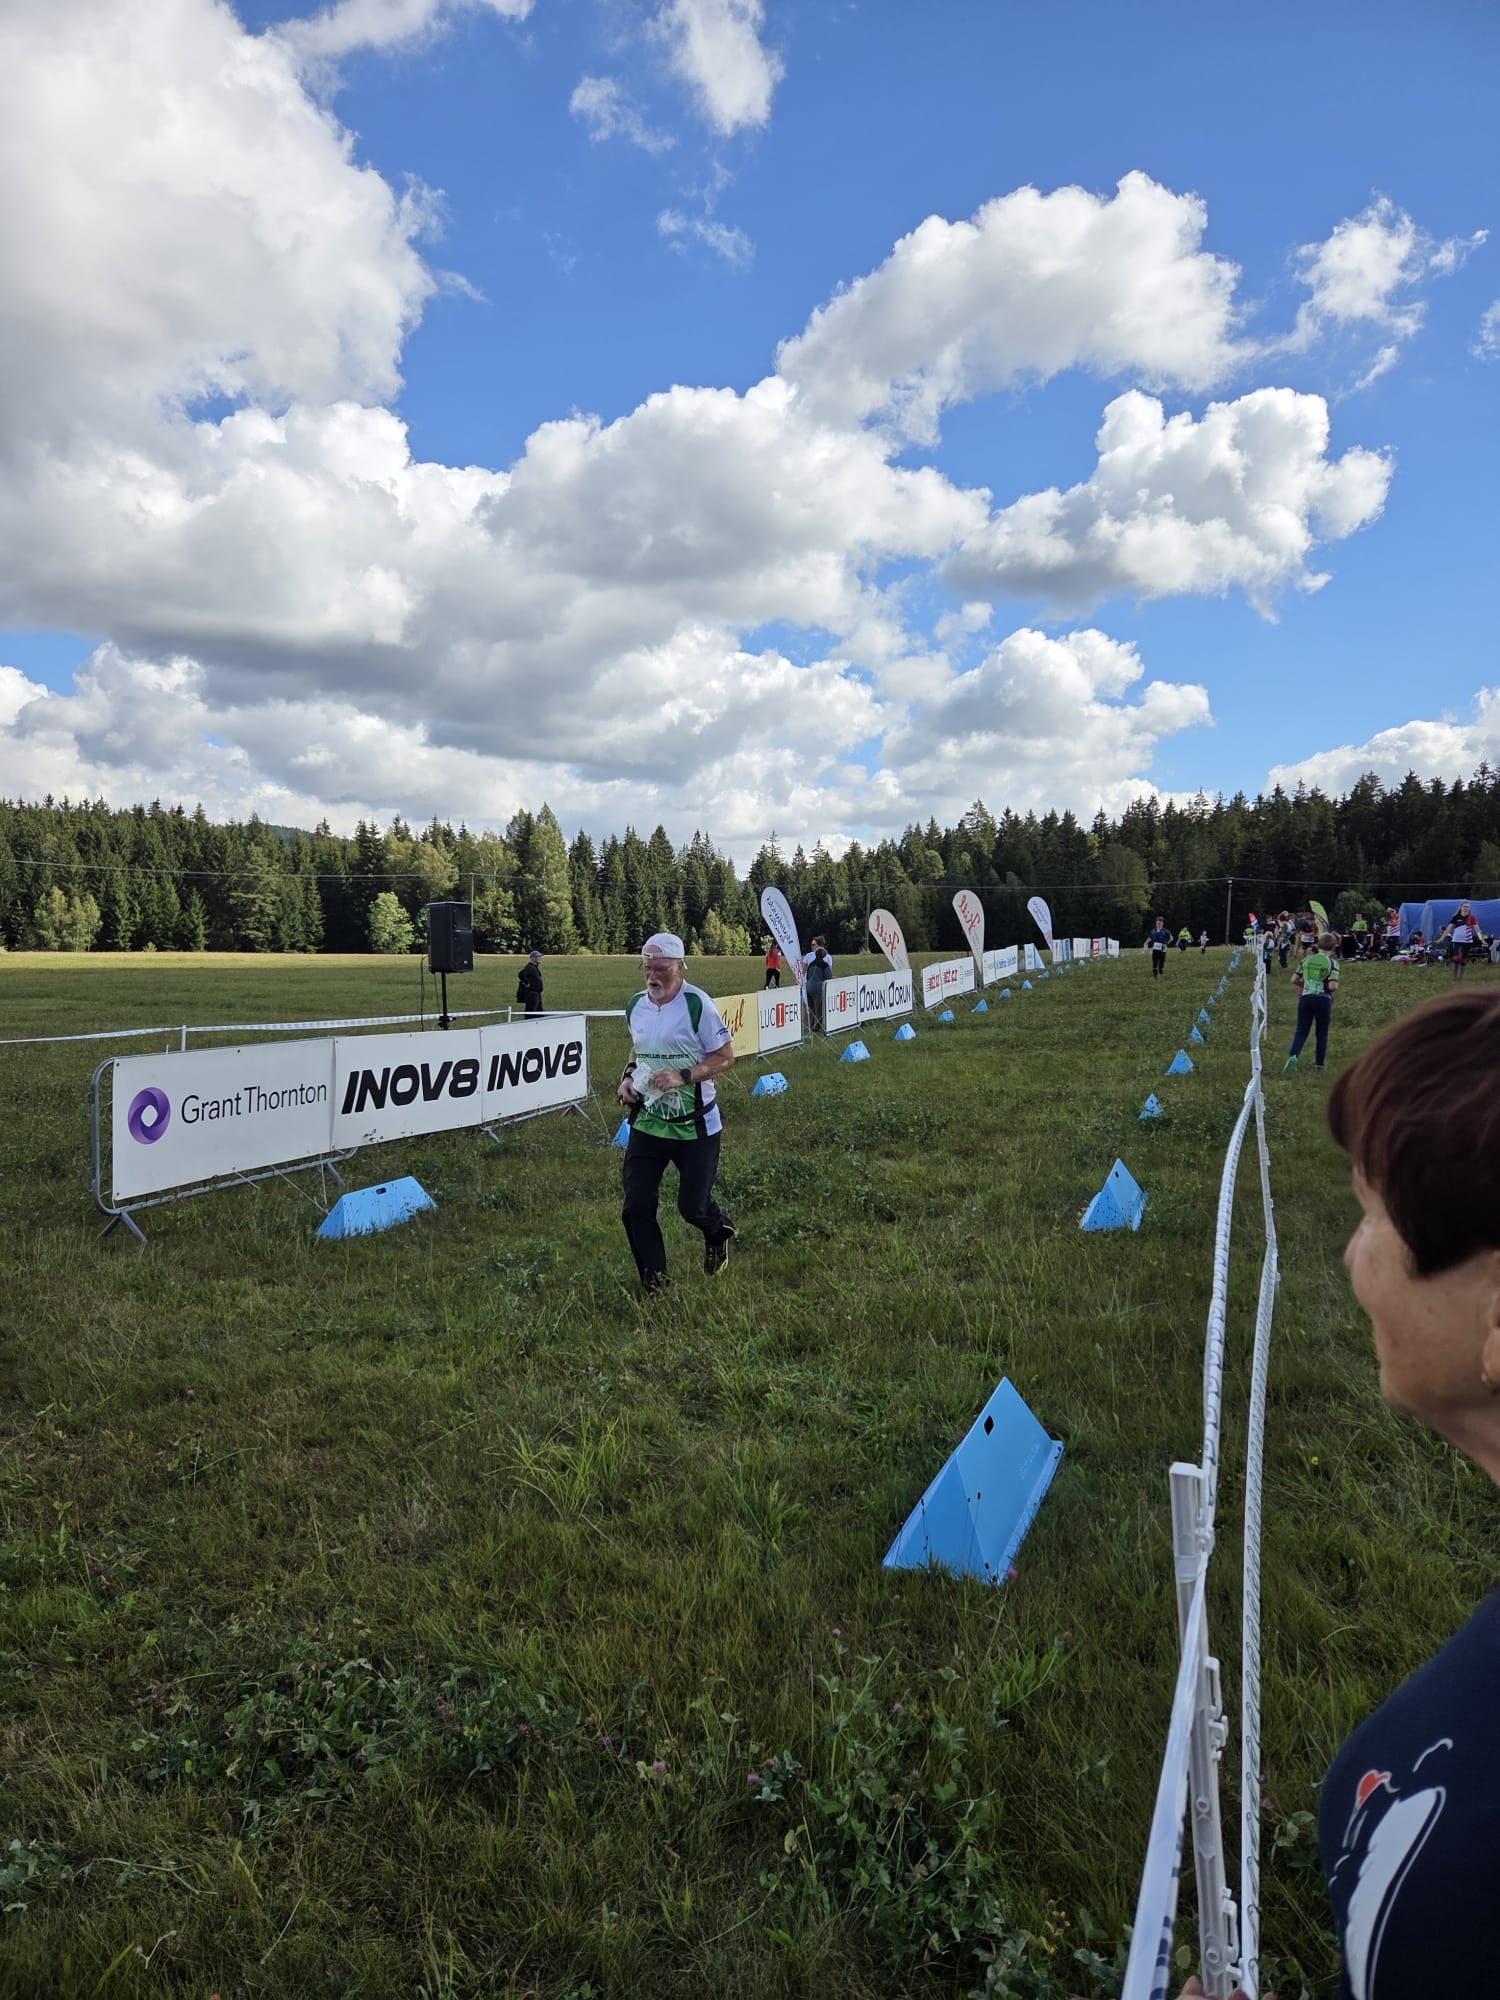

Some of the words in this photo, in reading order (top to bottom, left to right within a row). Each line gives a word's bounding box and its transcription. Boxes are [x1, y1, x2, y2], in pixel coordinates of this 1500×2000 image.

[760, 1002, 799, 1029] LUCIFER
[828, 990, 856, 1013] LUCIFER
[860, 984, 886, 1013] DORUN
[487, 1041, 583, 1092] INOV8
[181, 1094, 242, 1124] Grant
[244, 1083, 327, 1114] Thornton
[341, 1058, 480, 1115] INOV8
